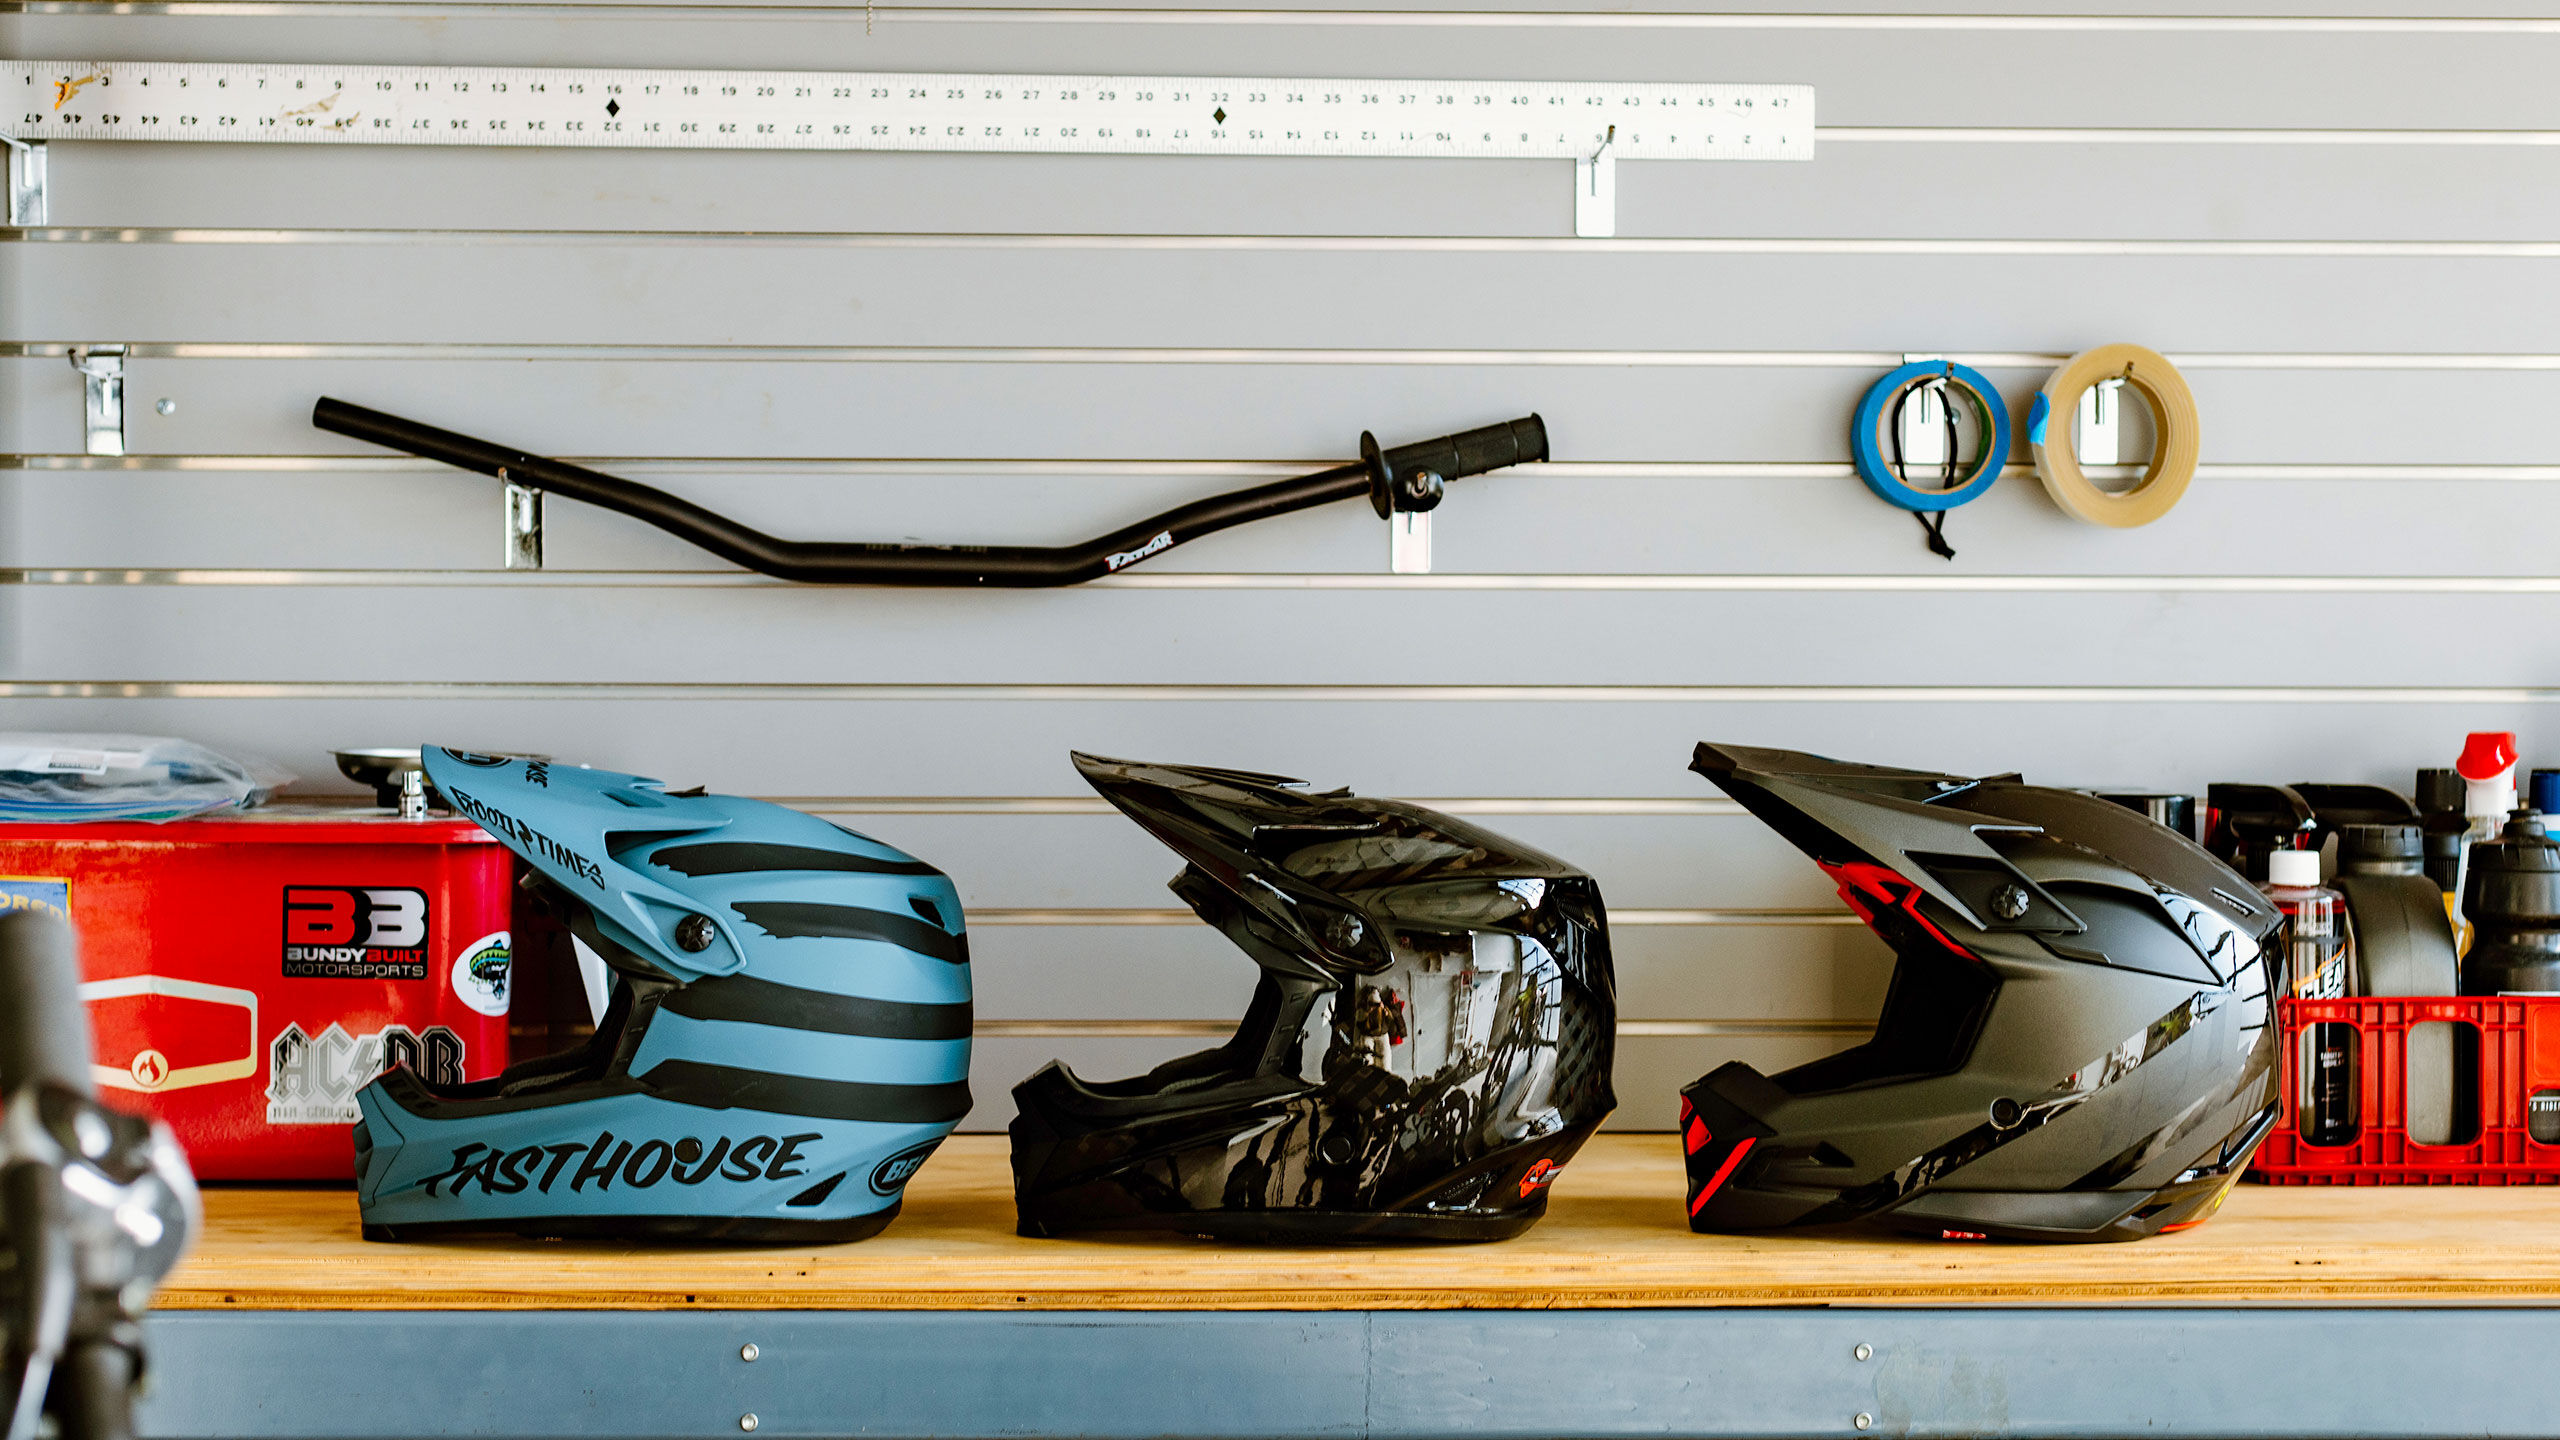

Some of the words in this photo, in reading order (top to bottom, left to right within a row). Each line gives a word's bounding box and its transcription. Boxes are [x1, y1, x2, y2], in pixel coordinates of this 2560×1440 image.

[25, 75, 31, 86] 1
[101, 76, 110, 87] 3
[140, 77, 148, 87] 4
[179, 77, 187, 88] 5
[218, 78, 226, 89] 6
[258, 78, 265, 89] 7
[295, 79, 304, 90] 8
[334, 80, 342, 91] 9
[376, 81, 392, 91] 10
[415, 82, 429, 92] 11
[453, 81, 469, 93] 12
[491, 82, 507, 93] 13
[530, 83, 545, 93] 14
[568, 84, 584, 94] 15
[607, 84, 622, 95] 16
[645, 85, 660, 95] 17
[683, 85, 699, 96] 18
[721, 86, 737, 97] 19
[757, 86, 775, 97] 20
[795, 87, 811, 97] 21
[833, 87, 851, 98] 22
[871, 88, 889, 98] 23
[909, 88, 927, 99] 24
[947, 89, 965, 100] 25
[984, 89, 1003, 100] 26
[1022, 89, 1040, 101] 27
[1060, 90, 1079, 101] 28
[1098, 90, 1116, 101] 29
[1135, 91, 1154, 102] 30
[1173, 92, 1190, 102] 31
[1211, 92, 1229, 103] 32
[1248, 92, 1267, 103] 33
[1286, 93, 1304, 103] 34
[1323, 93, 1342, 104] 35
[1361, 94, 1379, 104] 36
[1399, 94, 1416, 105] 37
[1436, 95, 1454, 105] 38
[1473, 95, 1492, 106] 39
[1510, 95, 1529, 106] 40
[1548, 96, 1565, 106] 41
[1585, 96, 1603, 106] 42
[1622, 96, 1641, 107] 43
[1660, 97, 1677, 107] 44
[1697, 97, 1715, 108] 45
[1734, 98, 1753, 109] 46
[1771, 98, 1789, 108] 47
[24, 113, 43, 124] 47
[63, 113, 82, 124] 46
[102, 114, 121, 125] 45
[141, 115, 160, 125] 44
[180, 115, 198, 126] 43
[218, 116, 237, 126] 42
[259, 117, 276, 126] 41
[373, 118, 391, 129] 38
[412, 119, 430, 129] 37
[450, 119, 468, 130] 36
[488, 120, 507, 130] 35
[527, 120, 545, 131] 34
[565, 121, 584, 132] 33
[603, 121, 622, 132] 32
[643, 122, 660, 133] 31
[680, 122, 698, 133] 30
[718, 123, 736, 133] 29
[757, 123, 775, 134] 28
[795, 124, 813, 135] 27
[832, 124, 851, 135] 26
[870, 125, 889, 136] 25
[909, 125, 926, 136] 24
[946, 126, 965, 137] 23
[984, 126, 1002, 137] 22
[1024, 127, 1040, 137] 21
[1060, 127, 1078, 138] 20
[1097, 127, 1113, 138] 19
[1135, 128, 1152, 139] 18
[1173, 129, 1189, 139] 17
[1210, 129, 1227, 139] 16
[1248, 129, 1264, 140] 15
[1286, 130, 1302, 140] 14
[1323, 130, 1339, 141] 13
[1361, 131, 1377, 141] 12
[1400, 131, 1414, 141] 11
[1435, 131, 1451, 142] 10
[1482, 132, 1492, 143] 9
[1520, 132, 1529, 143] 8
[1558, 133, 1566, 144] 7
[1595, 133, 1603, 143] 6
[1632, 133, 1640, 144] 5
[1670, 134, 1678, 144] 4
[1706, 134, 1715, 144] 3
[1743, 134, 1751, 145] 2
[1780, 135, 1787, 145] 1
[449, 785, 517, 841] GOOD
[530, 828, 606, 891] TIMES
[285, 963, 425, 978] MOTORSPORTS
[413, 1130, 824, 1199] FASTHOUSE
